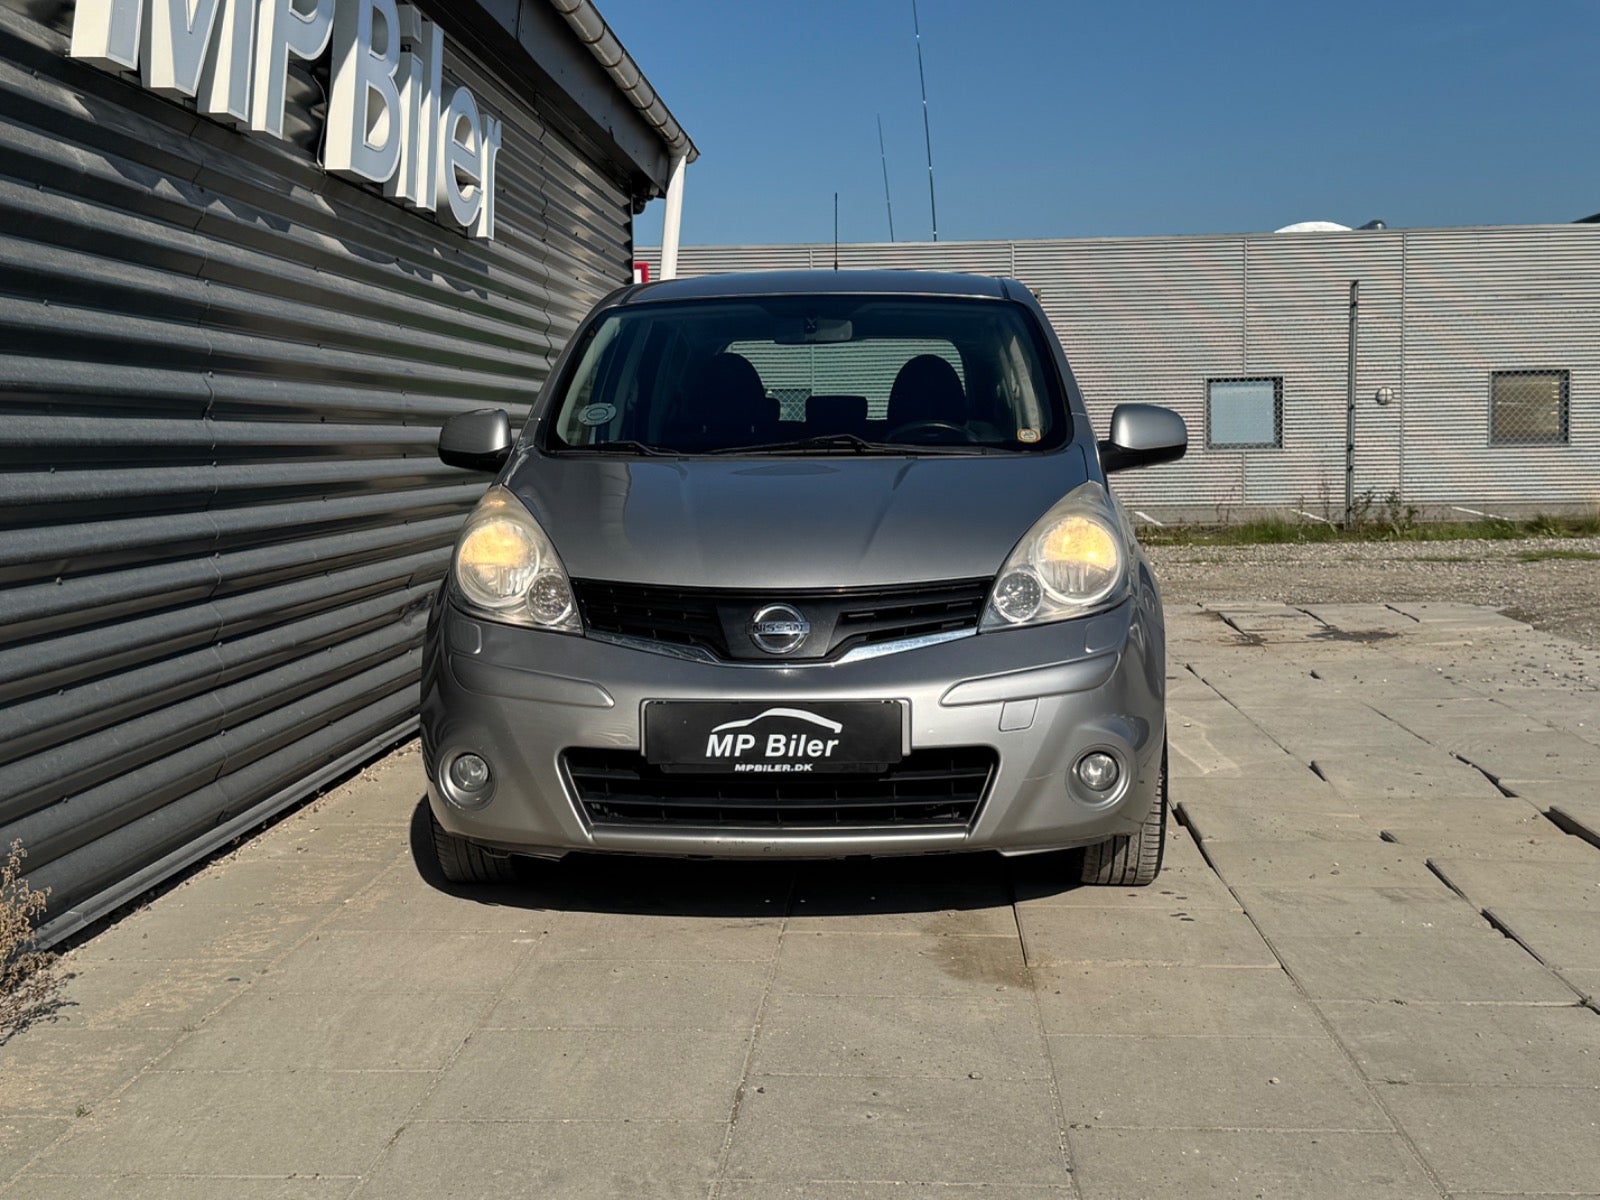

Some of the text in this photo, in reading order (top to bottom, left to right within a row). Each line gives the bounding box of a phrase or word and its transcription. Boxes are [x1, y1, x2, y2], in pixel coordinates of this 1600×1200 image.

[325, 0, 502, 241] Biler
[752, 622, 803, 632] NISSAN
[705, 734, 840, 757] MP Biler
[734, 763, 814, 772] MPBILER.DK
